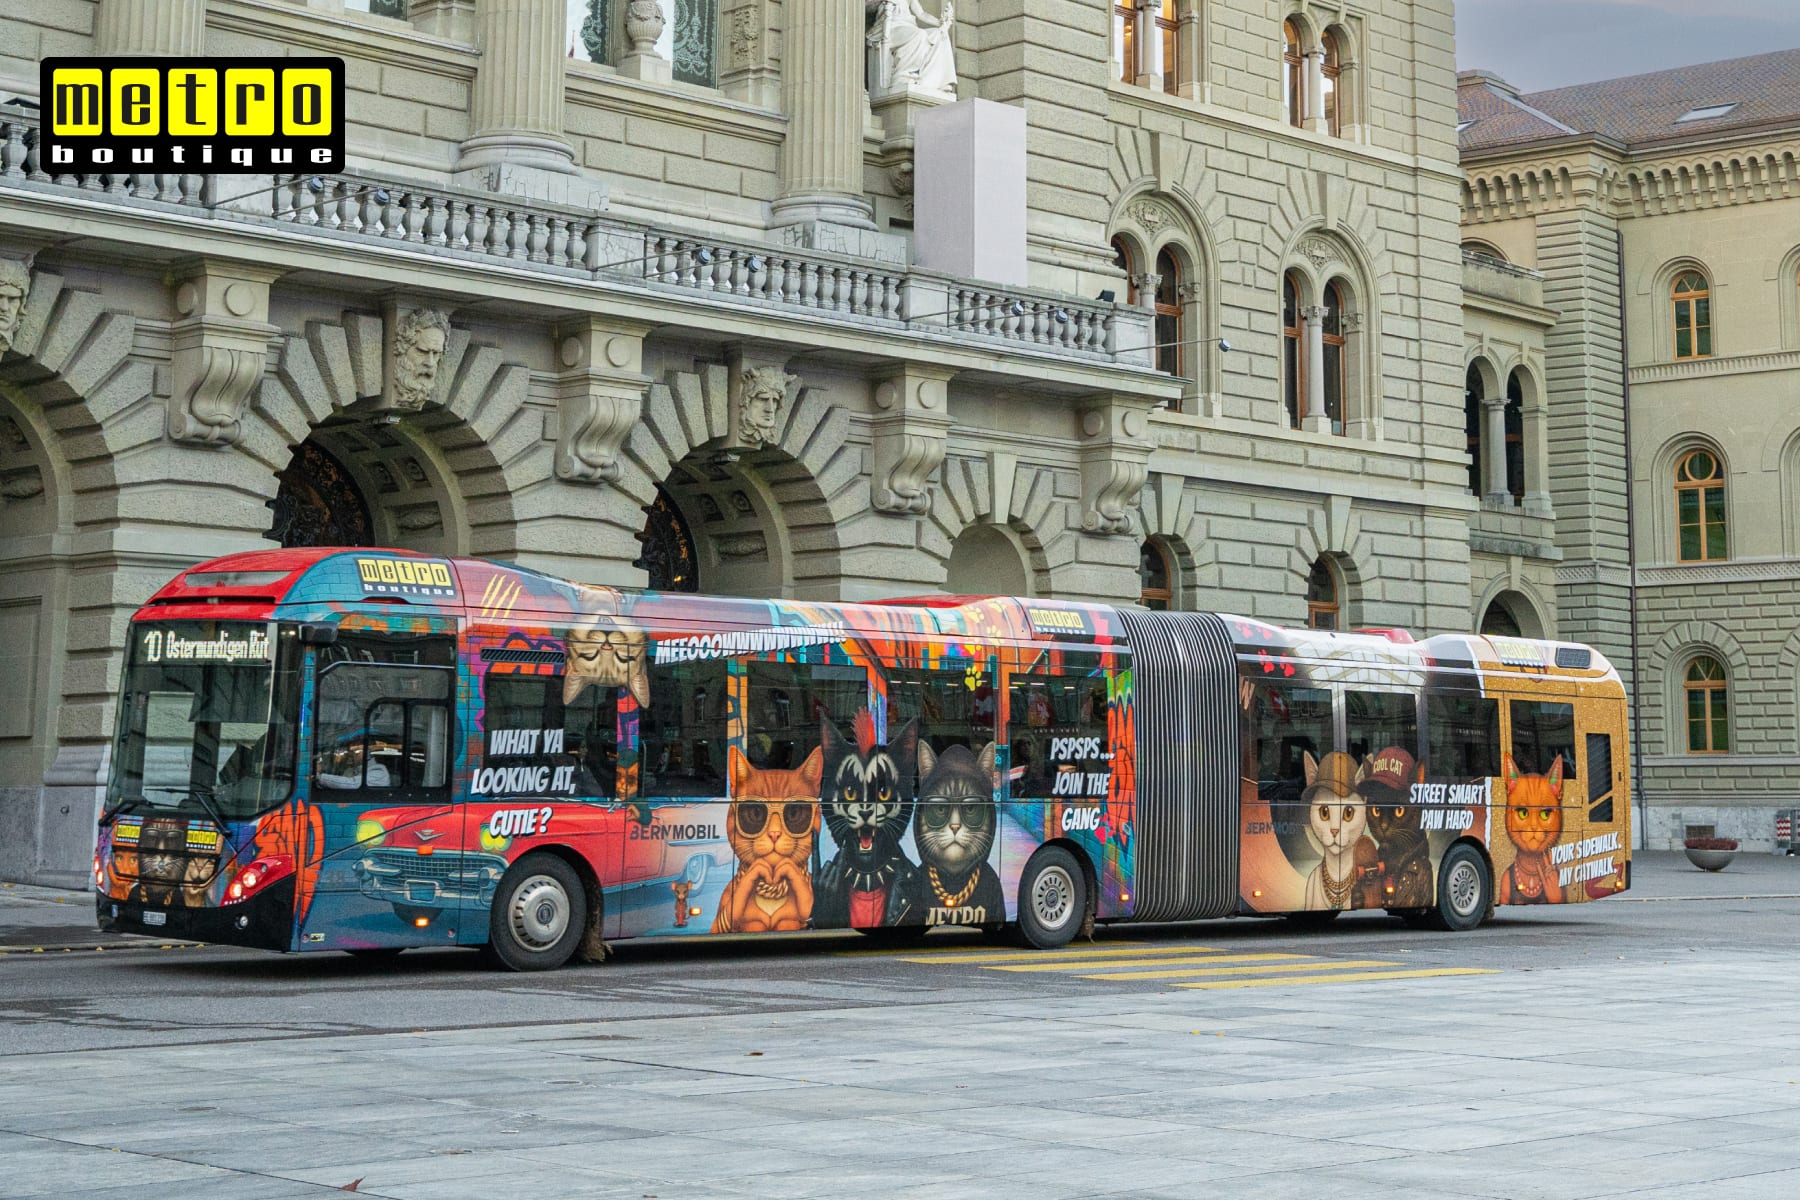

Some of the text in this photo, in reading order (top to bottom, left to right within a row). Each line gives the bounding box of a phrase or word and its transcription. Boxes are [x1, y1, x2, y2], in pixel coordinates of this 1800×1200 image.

[360, 562, 448, 583] metro
[363, 583, 455, 596] boutique
[144, 630, 162, 662] 10
[166, 630, 248, 662] Ostermundigen
[489, 728, 564, 756] WHAT YA
[1050, 737, 1115, 761] PSPSPS...
[1373, 758, 1404, 776] COOL CAT
[470, 765, 577, 795] LOOKING AT,
[1052, 771, 1111, 796] JOIN THE
[1409, 783, 1485, 805] STREET SMART
[1061, 807, 1101, 832] GANG
[1420, 809, 1474, 830] PAW HARD
[1551, 831, 1622, 865] YOUR SIDEWALK.
[1558, 855, 1618, 888] MY CATWALK.
